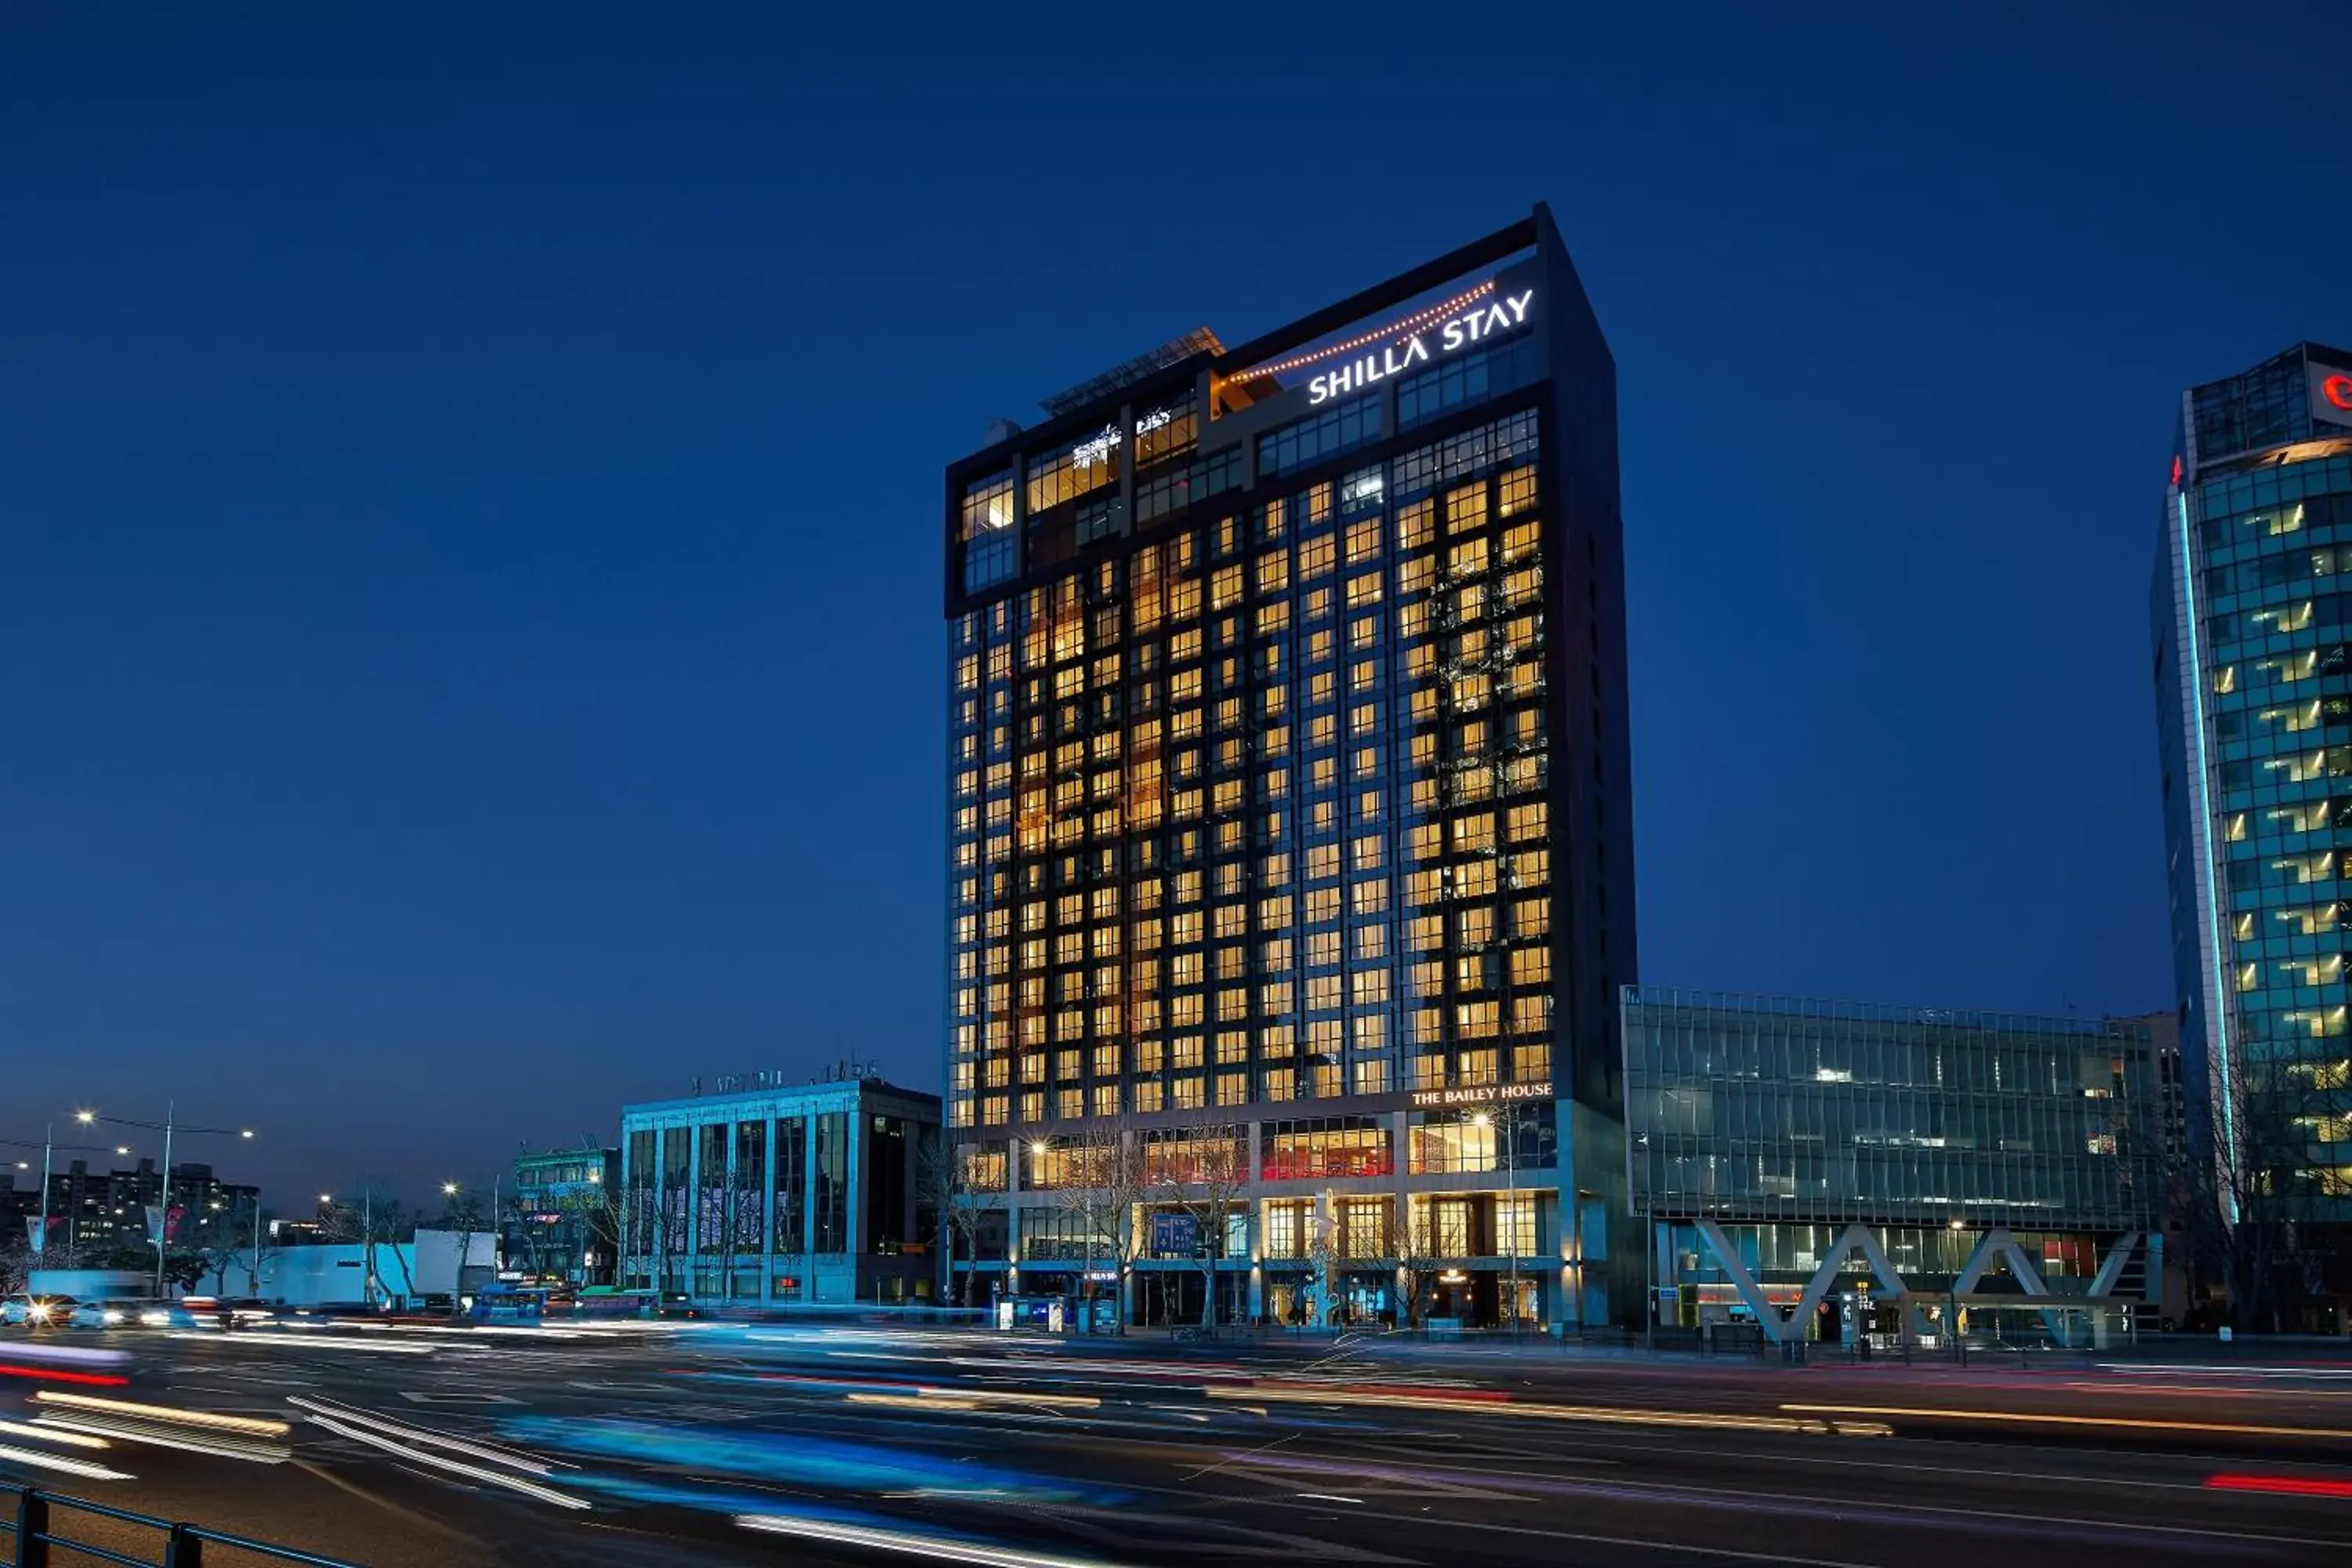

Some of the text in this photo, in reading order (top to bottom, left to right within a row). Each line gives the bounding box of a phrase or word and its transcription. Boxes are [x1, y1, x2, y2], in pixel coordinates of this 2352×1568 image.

[1309, 289, 1533, 404] SHILLA STAY
[1412, 1083, 1553, 1105] THE BAILEY HOUSE
